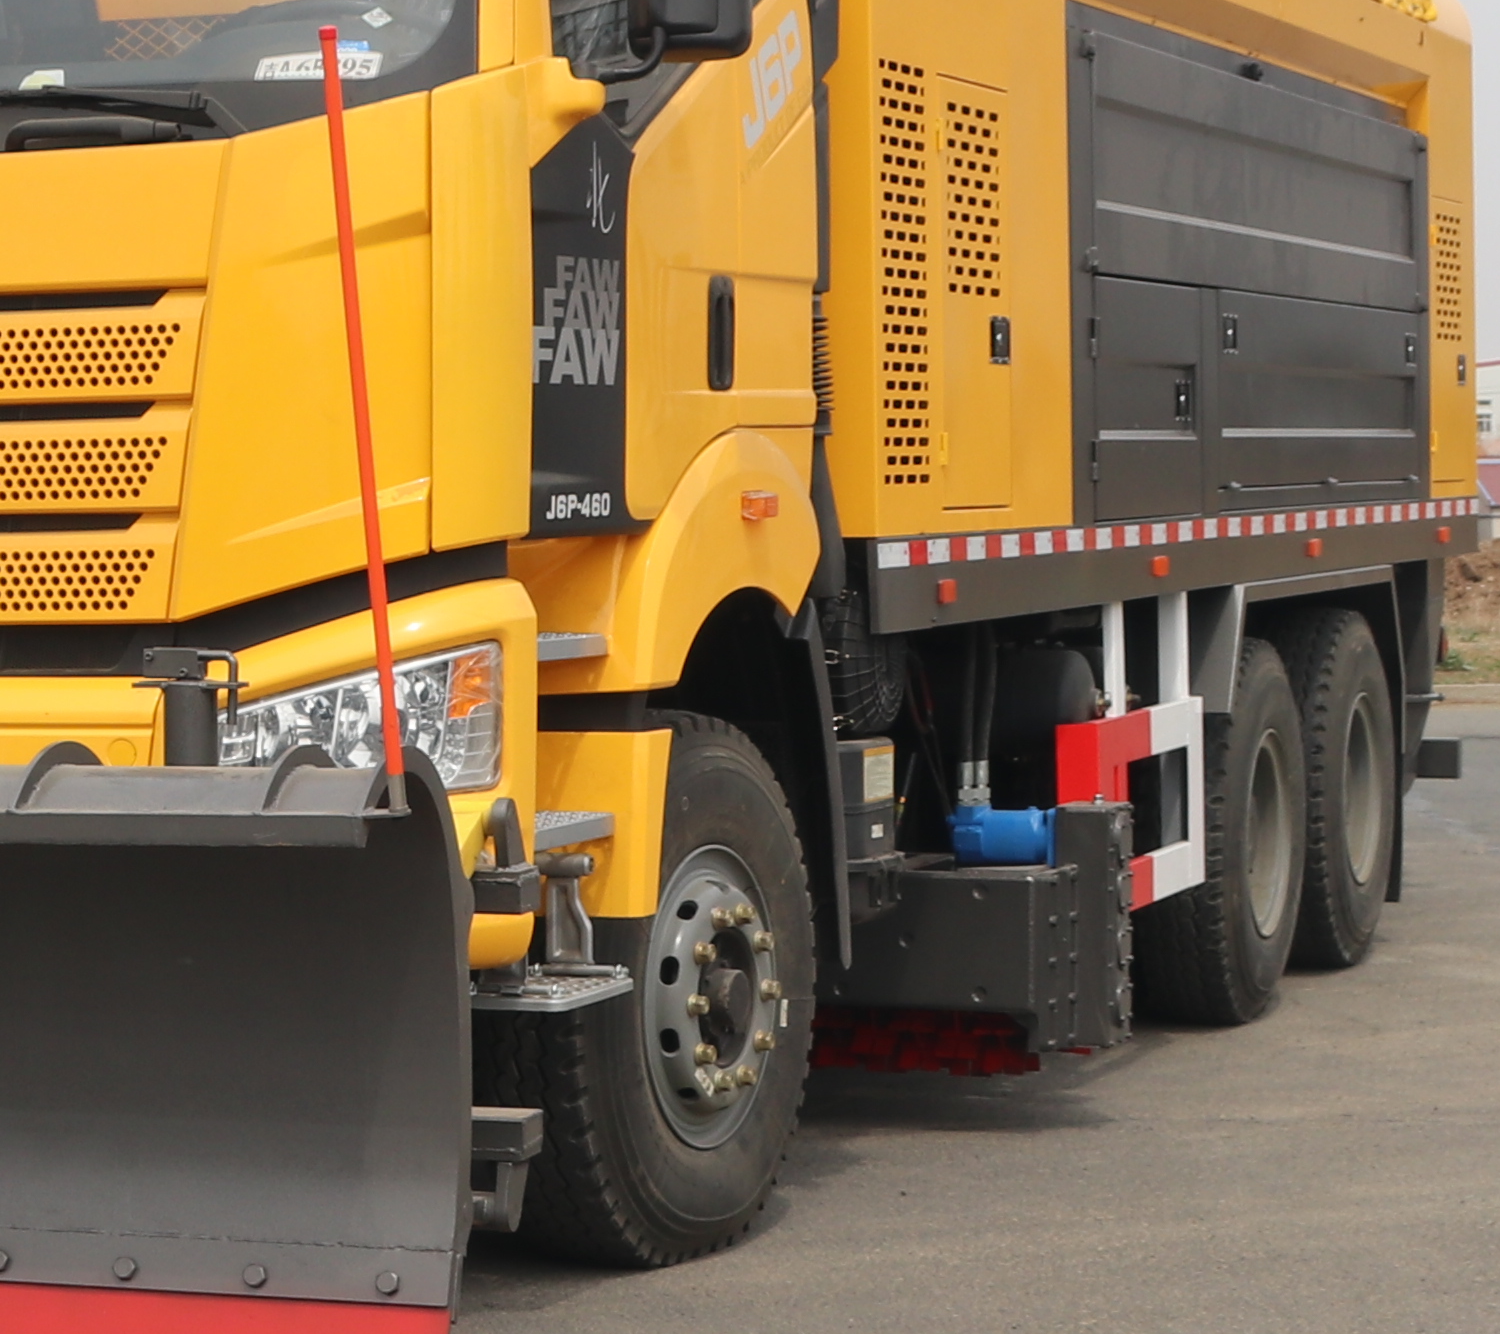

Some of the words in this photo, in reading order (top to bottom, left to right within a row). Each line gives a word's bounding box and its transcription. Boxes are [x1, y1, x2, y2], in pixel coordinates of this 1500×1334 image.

[742, 10, 803, 149] J6P
[556, 255, 620, 299] FAW
[543, 287, 620, 335] FAW
[533, 324, 620, 386] FAW
[546, 492, 611, 520] J6P-460
